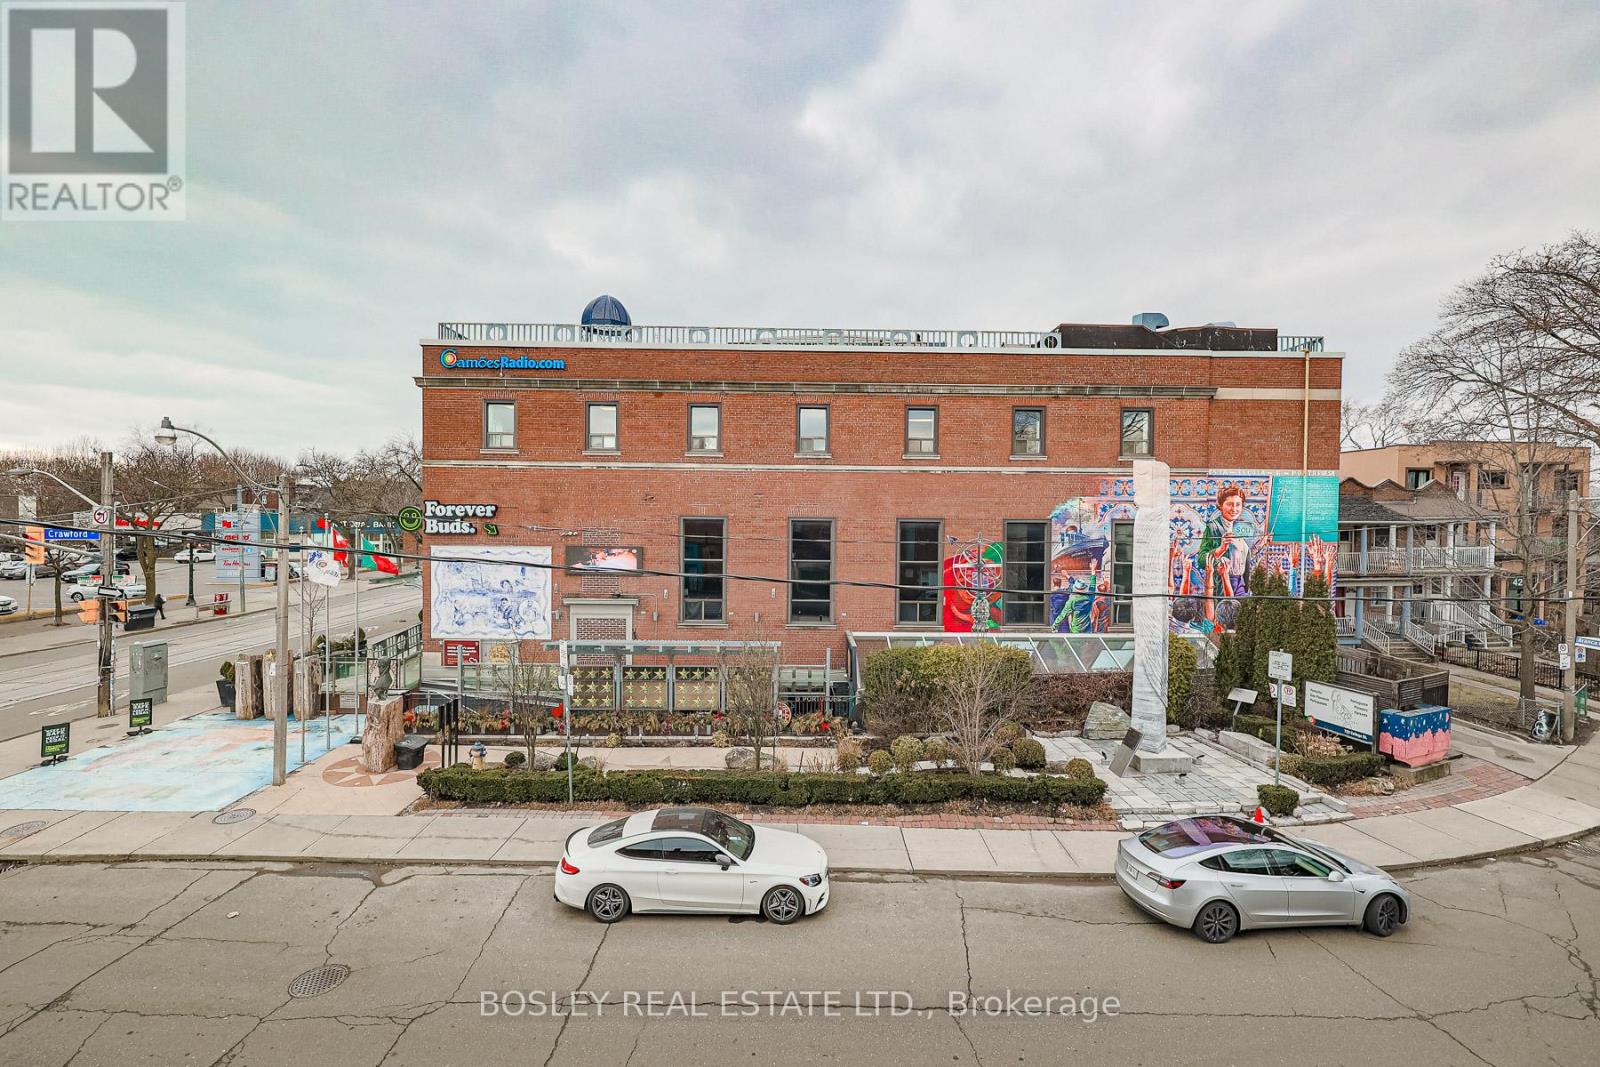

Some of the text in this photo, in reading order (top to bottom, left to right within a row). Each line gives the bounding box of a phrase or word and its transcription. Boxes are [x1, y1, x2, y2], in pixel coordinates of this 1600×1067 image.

[440, 348, 566, 370] CamõesRadio.com
[424, 501, 496, 517] Forever
[48, 530, 88, 538] Crawford
[424, 518, 476, 534] Buds.
[1512, 578, 1523, 587] 42
